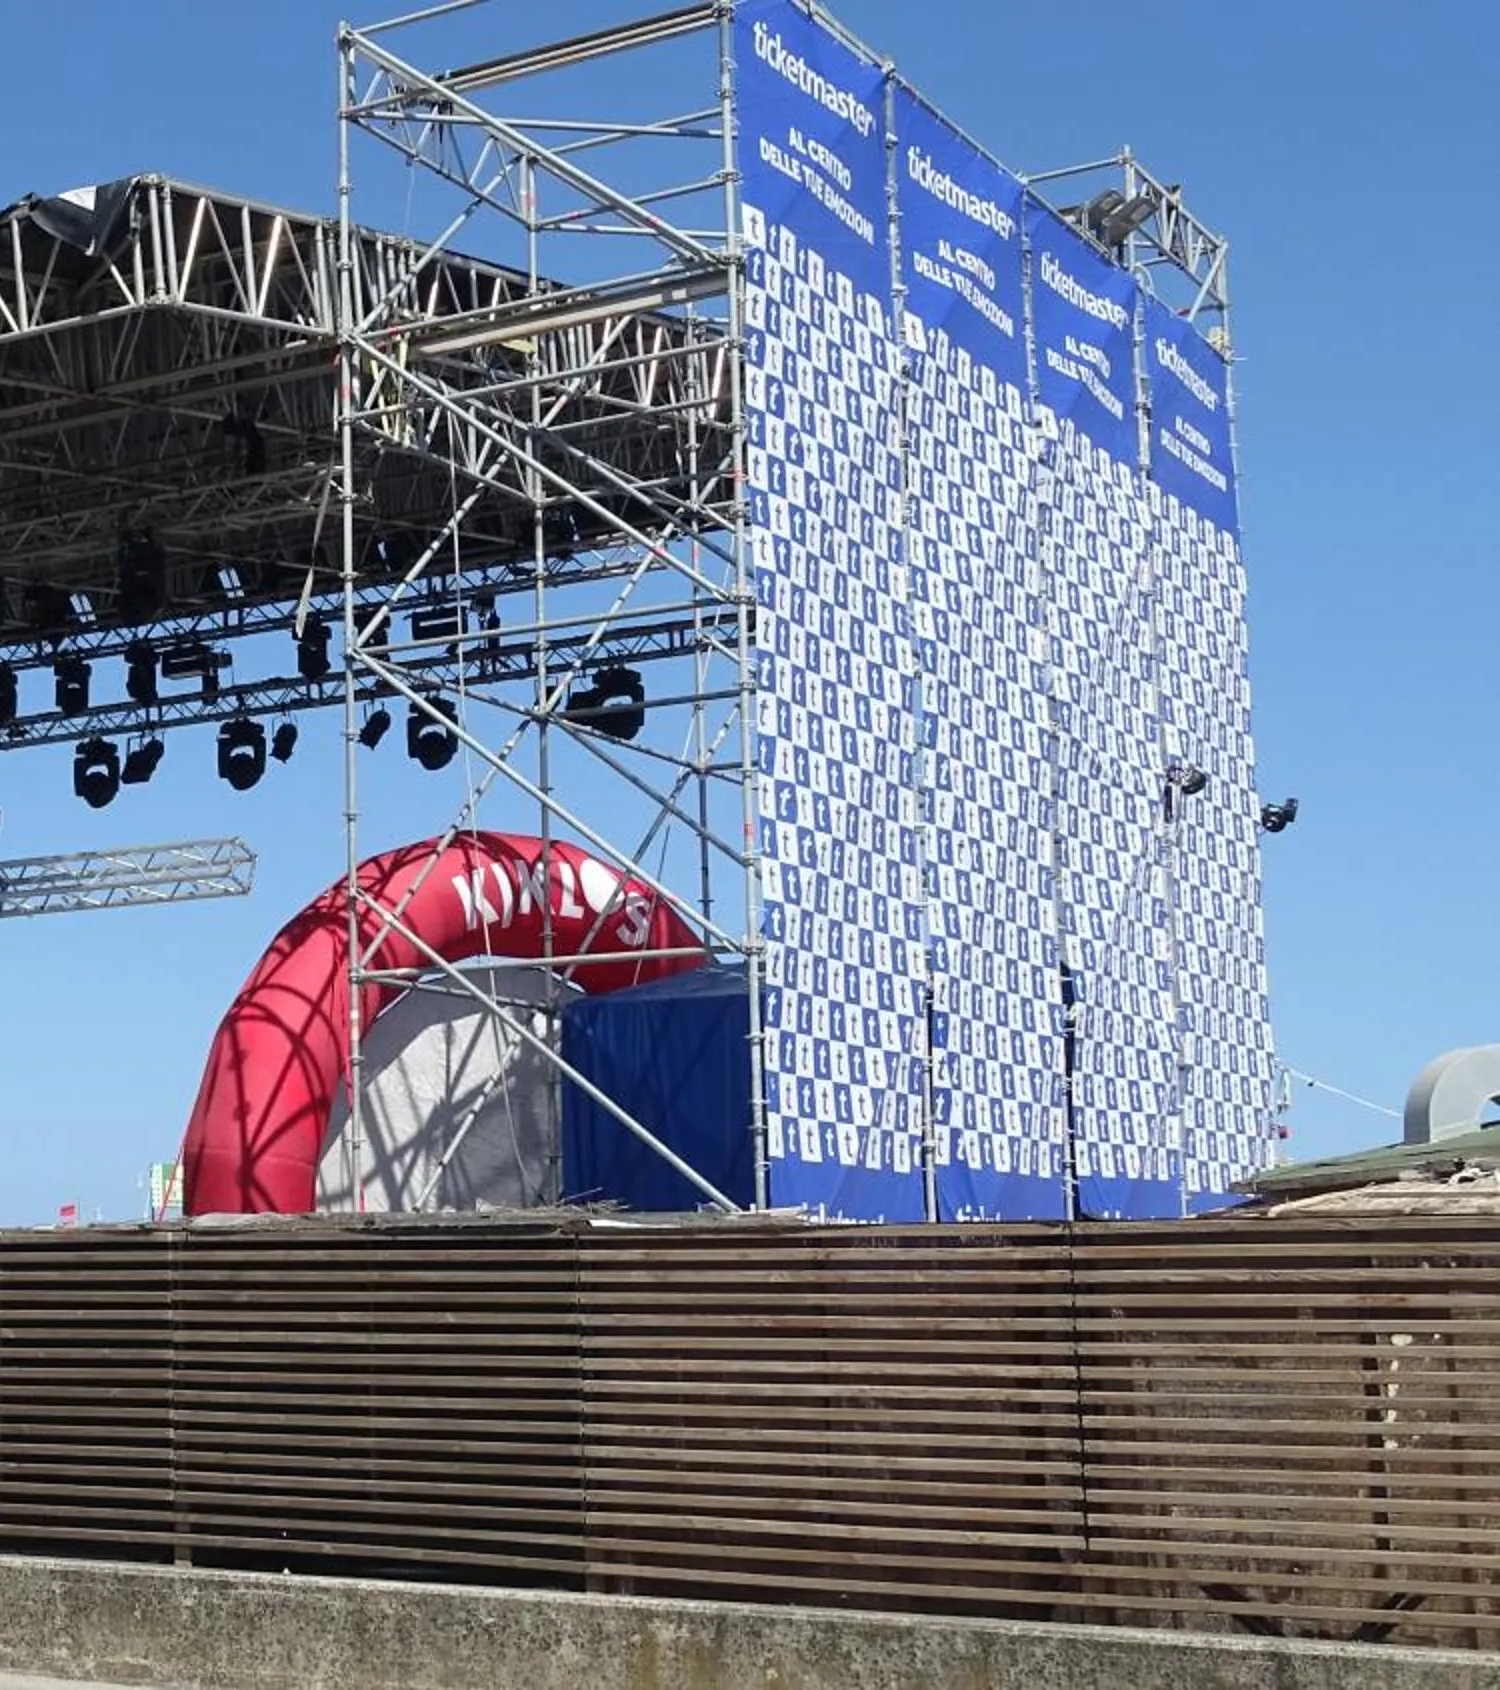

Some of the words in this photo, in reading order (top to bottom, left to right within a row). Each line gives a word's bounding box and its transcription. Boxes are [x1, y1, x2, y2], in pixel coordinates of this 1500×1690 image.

[753, 21, 875, 136] ticketmaster
[759, 137, 802, 182] DELLE
[802, 164, 824, 201] TUE
[823, 183, 875, 245] EMOZIONI
[789, 127, 806, 155] AL
[807, 139, 851, 191] CENTRO
[907, 145, 1016, 240] ticketmaster
[913, 251, 953, 288] DELLE
[938, 239, 955, 264] AL
[955, 248, 996, 291] CENTRO
[1041, 251, 1129, 331] ticketmaster
[1155, 337, 1219, 412] ticketmaster
